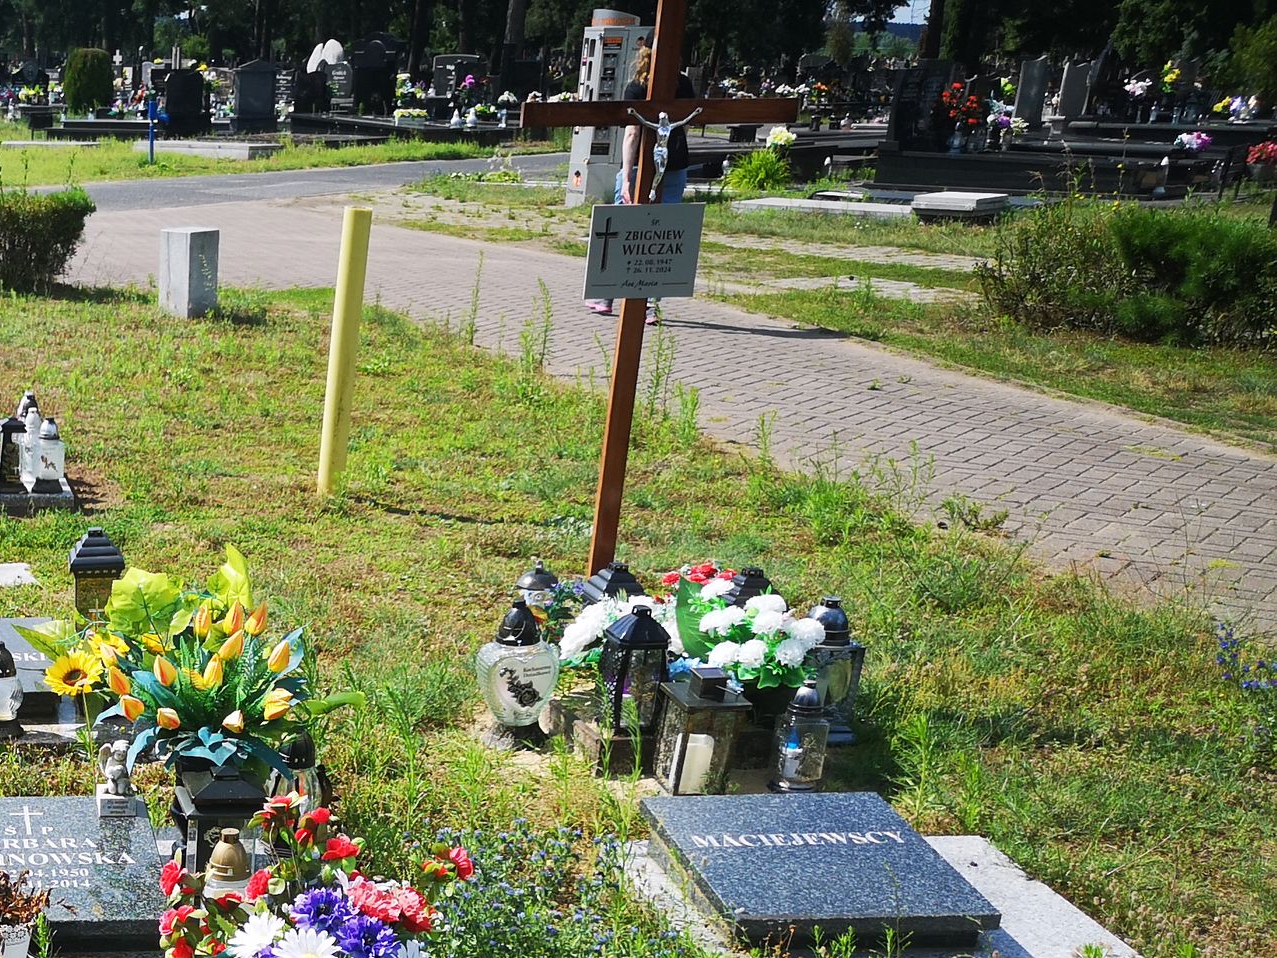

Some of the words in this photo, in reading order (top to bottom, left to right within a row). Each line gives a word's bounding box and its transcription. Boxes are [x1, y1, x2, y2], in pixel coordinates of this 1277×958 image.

[625, 230, 685, 241] ZBIGNIEW
[623, 243, 683, 256] WILCZAK
[42, 826, 54, 835] P
[691, 831, 906, 848] MACIEJEWSCY
